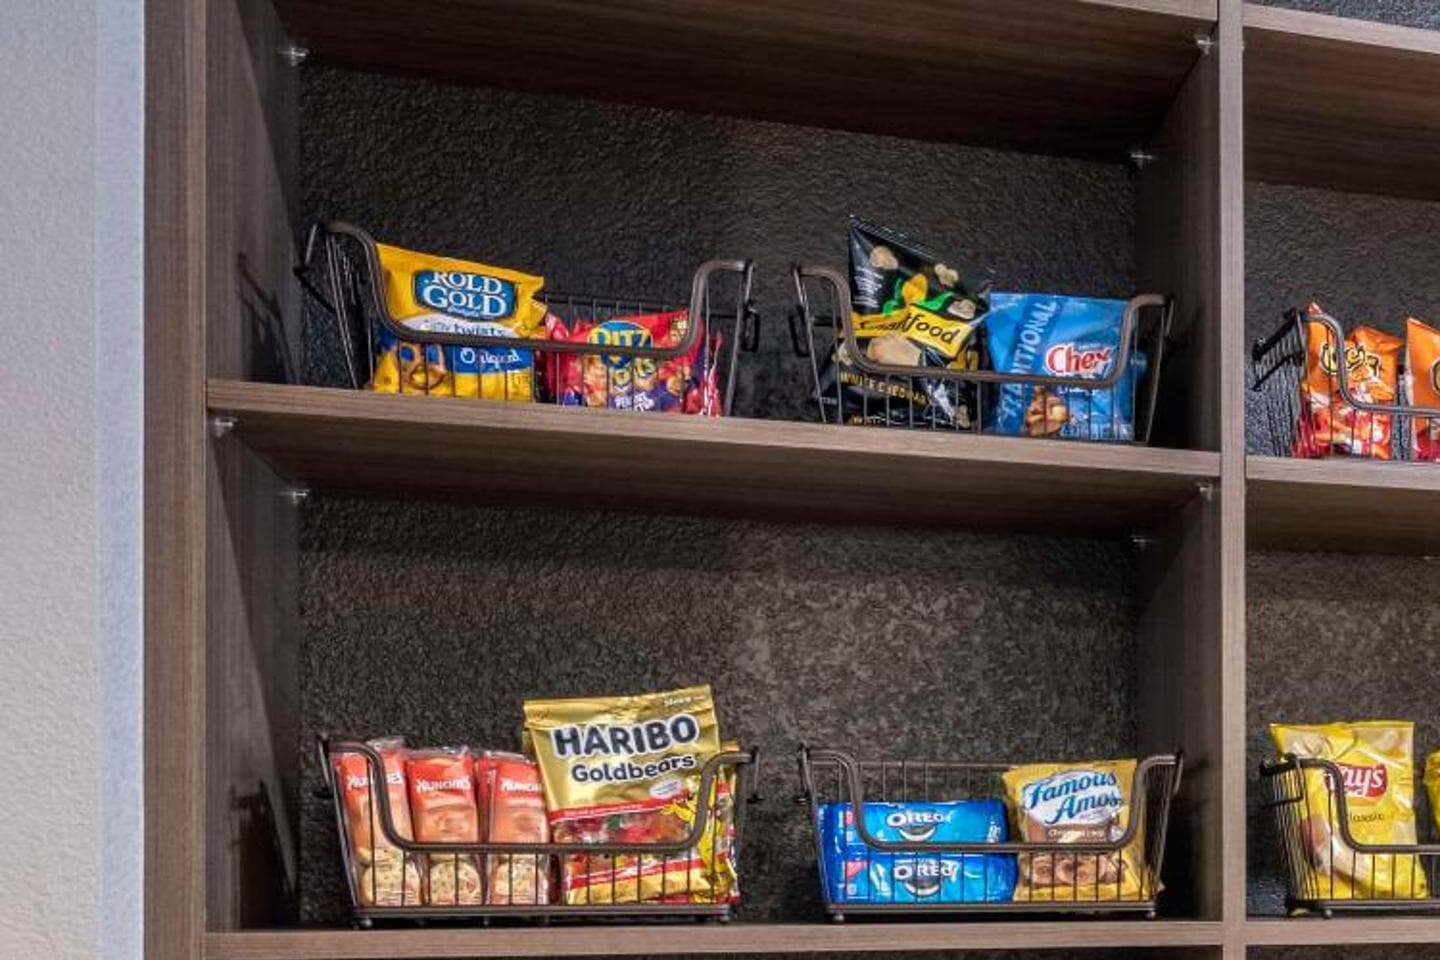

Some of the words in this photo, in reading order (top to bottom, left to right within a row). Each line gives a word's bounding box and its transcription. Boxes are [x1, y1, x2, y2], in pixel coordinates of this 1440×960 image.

[432, 271, 503, 295] ROLD
[423, 285, 508, 317] GOLD
[1047, 345, 1111, 374] Chex
[554, 715, 698, 757] HARIBO
[572, 755, 695, 784] Goldbears
[1022, 771, 1117, 810] Famous
[887, 812, 945, 828] OREO
[1044, 793, 1123, 824] Amos
